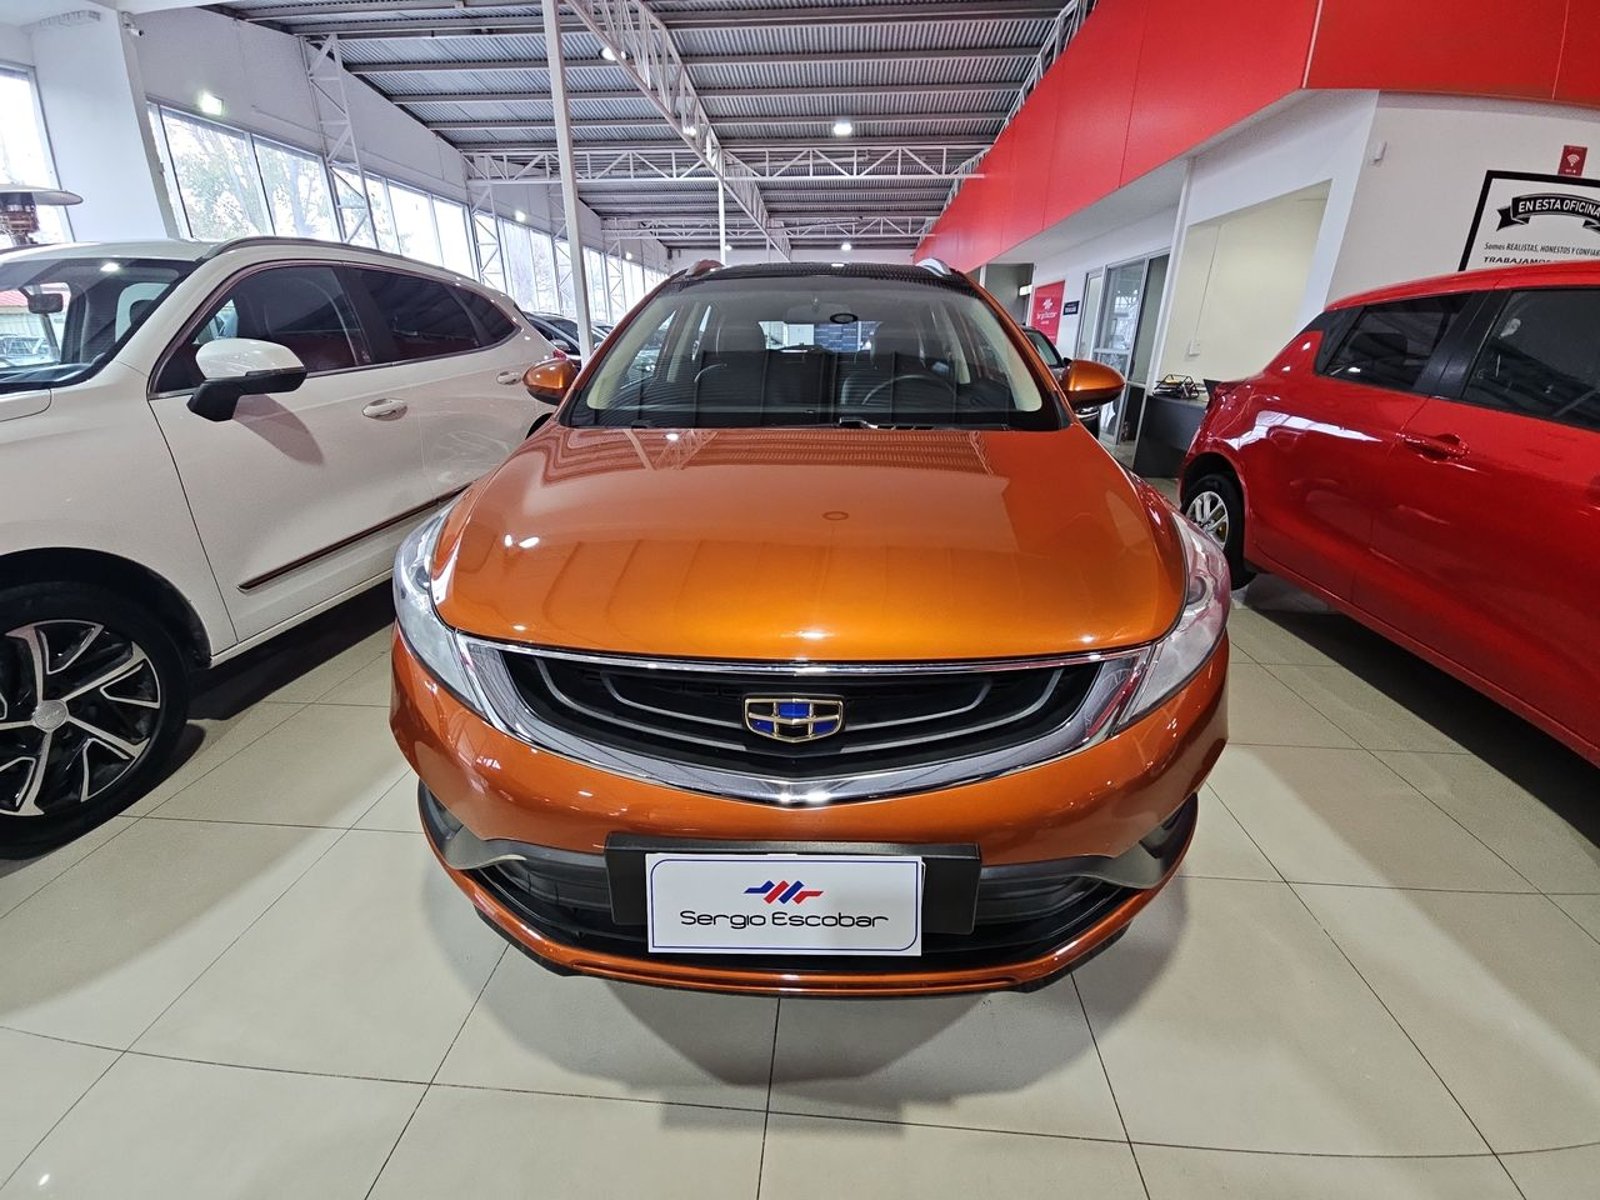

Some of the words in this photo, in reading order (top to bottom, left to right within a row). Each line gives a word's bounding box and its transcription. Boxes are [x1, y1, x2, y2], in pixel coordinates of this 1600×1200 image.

[1518, 200, 1534, 213] EN
[1535, 199, 1561, 211] ESTA
[1563, 200, 1600, 217] OFICINA
[1484, 242, 1505, 251] Somos
[1540, 244, 1570, 255] HONESTOS
[680, 910, 766, 930] Sergio
[772, 911, 889, 928] Escobar
